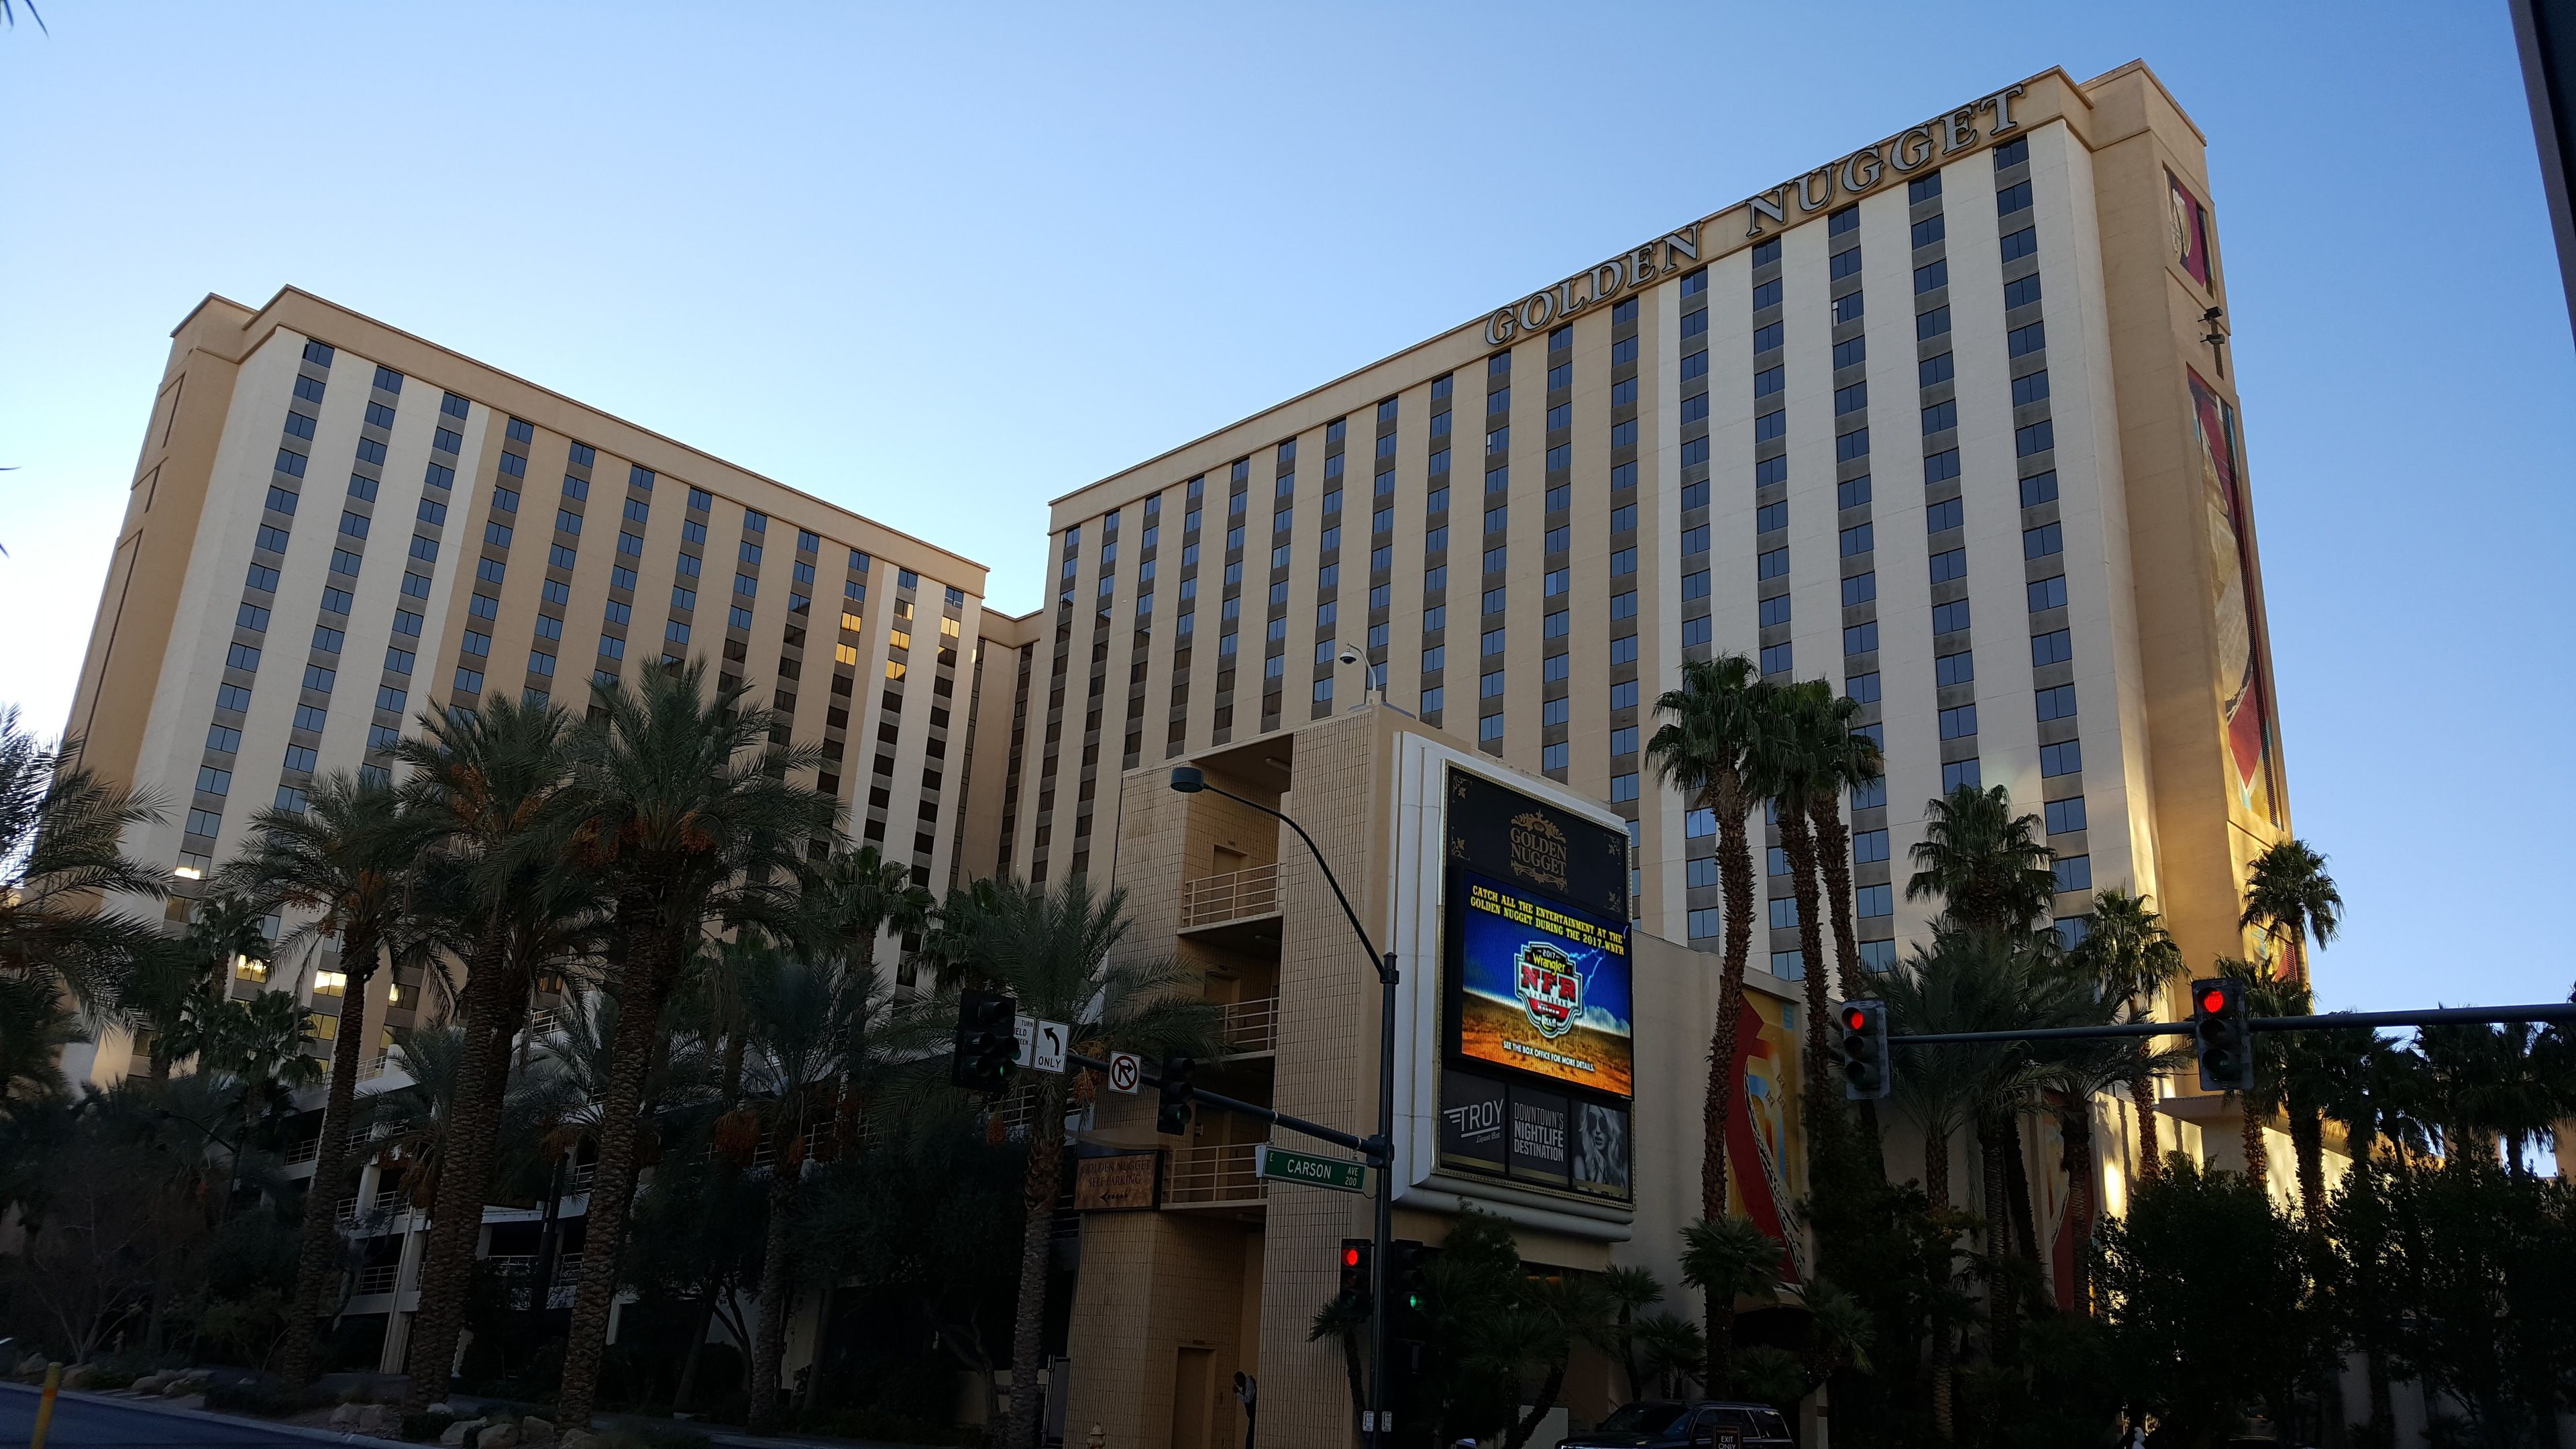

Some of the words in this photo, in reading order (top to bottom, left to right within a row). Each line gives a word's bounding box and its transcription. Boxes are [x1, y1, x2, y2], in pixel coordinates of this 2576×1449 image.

[1485, 220, 1701, 346] GOLDEN
[1746, 83, 2024, 237] NUGGET
[1510, 827, 1567, 862] GOLDEN
[1510, 843, 1567, 877] NUGGET
[1470, 896, 1501, 914] GOLDEN
[1503, 907, 1533, 925] NUGGET
[1536, 917, 1563, 936] DURING
[1566, 928, 1580, 941] THE
[1582, 934, 1602, 949] 2017
[1605, 941, 1624, 956] WNFR
[1472, 885, 1498, 902] CATCH
[1501, 894, 1515, 908] ALL
[1518, 900, 1534, 914] THE
[1536, 906, 1595, 934] ENTERTAINMENT
[1597, 927, 1607, 938] AT
[1609, 930, 1623, 944] THE
[1532, 953, 1566, 975] Wrangler
[1543, 949, 1556, 959] 2017
[1521, 965, 1576, 1002] NFR
[1014, 1027, 1027, 1036] IELD
[1038, 1056, 1061, 1069] ONLY
[1503, 1040, 1511, 1050] SEE
[1513, 1042, 1521, 1052] THE
[1522, 1046, 1534, 1056] BOX
[1534, 1049, 1550, 1060] OFFICE
[1551, 1053, 1561, 1063] FOR
[1562, 1057, 1575, 1067] MORE
[1443, 1098, 1504, 1132] TROY
[1514, 1102, 1564, 1130] DOWNTOWN'S
[1514, 1120, 1564, 1148] NIGHTLIFE
[1514, 1138, 1564, 1163] DESTINATION
[1081, 1163, 1114, 1174] GOLDEN
[1117, 1159, 1150, 1171] NUGGET
[1269, 1152, 1274, 1162] E
[1287, 1159, 1332, 1179] CARSON
[1347, 1166, 1358, 1176] AVE
[1344, 1176, 1357, 1187] 200
